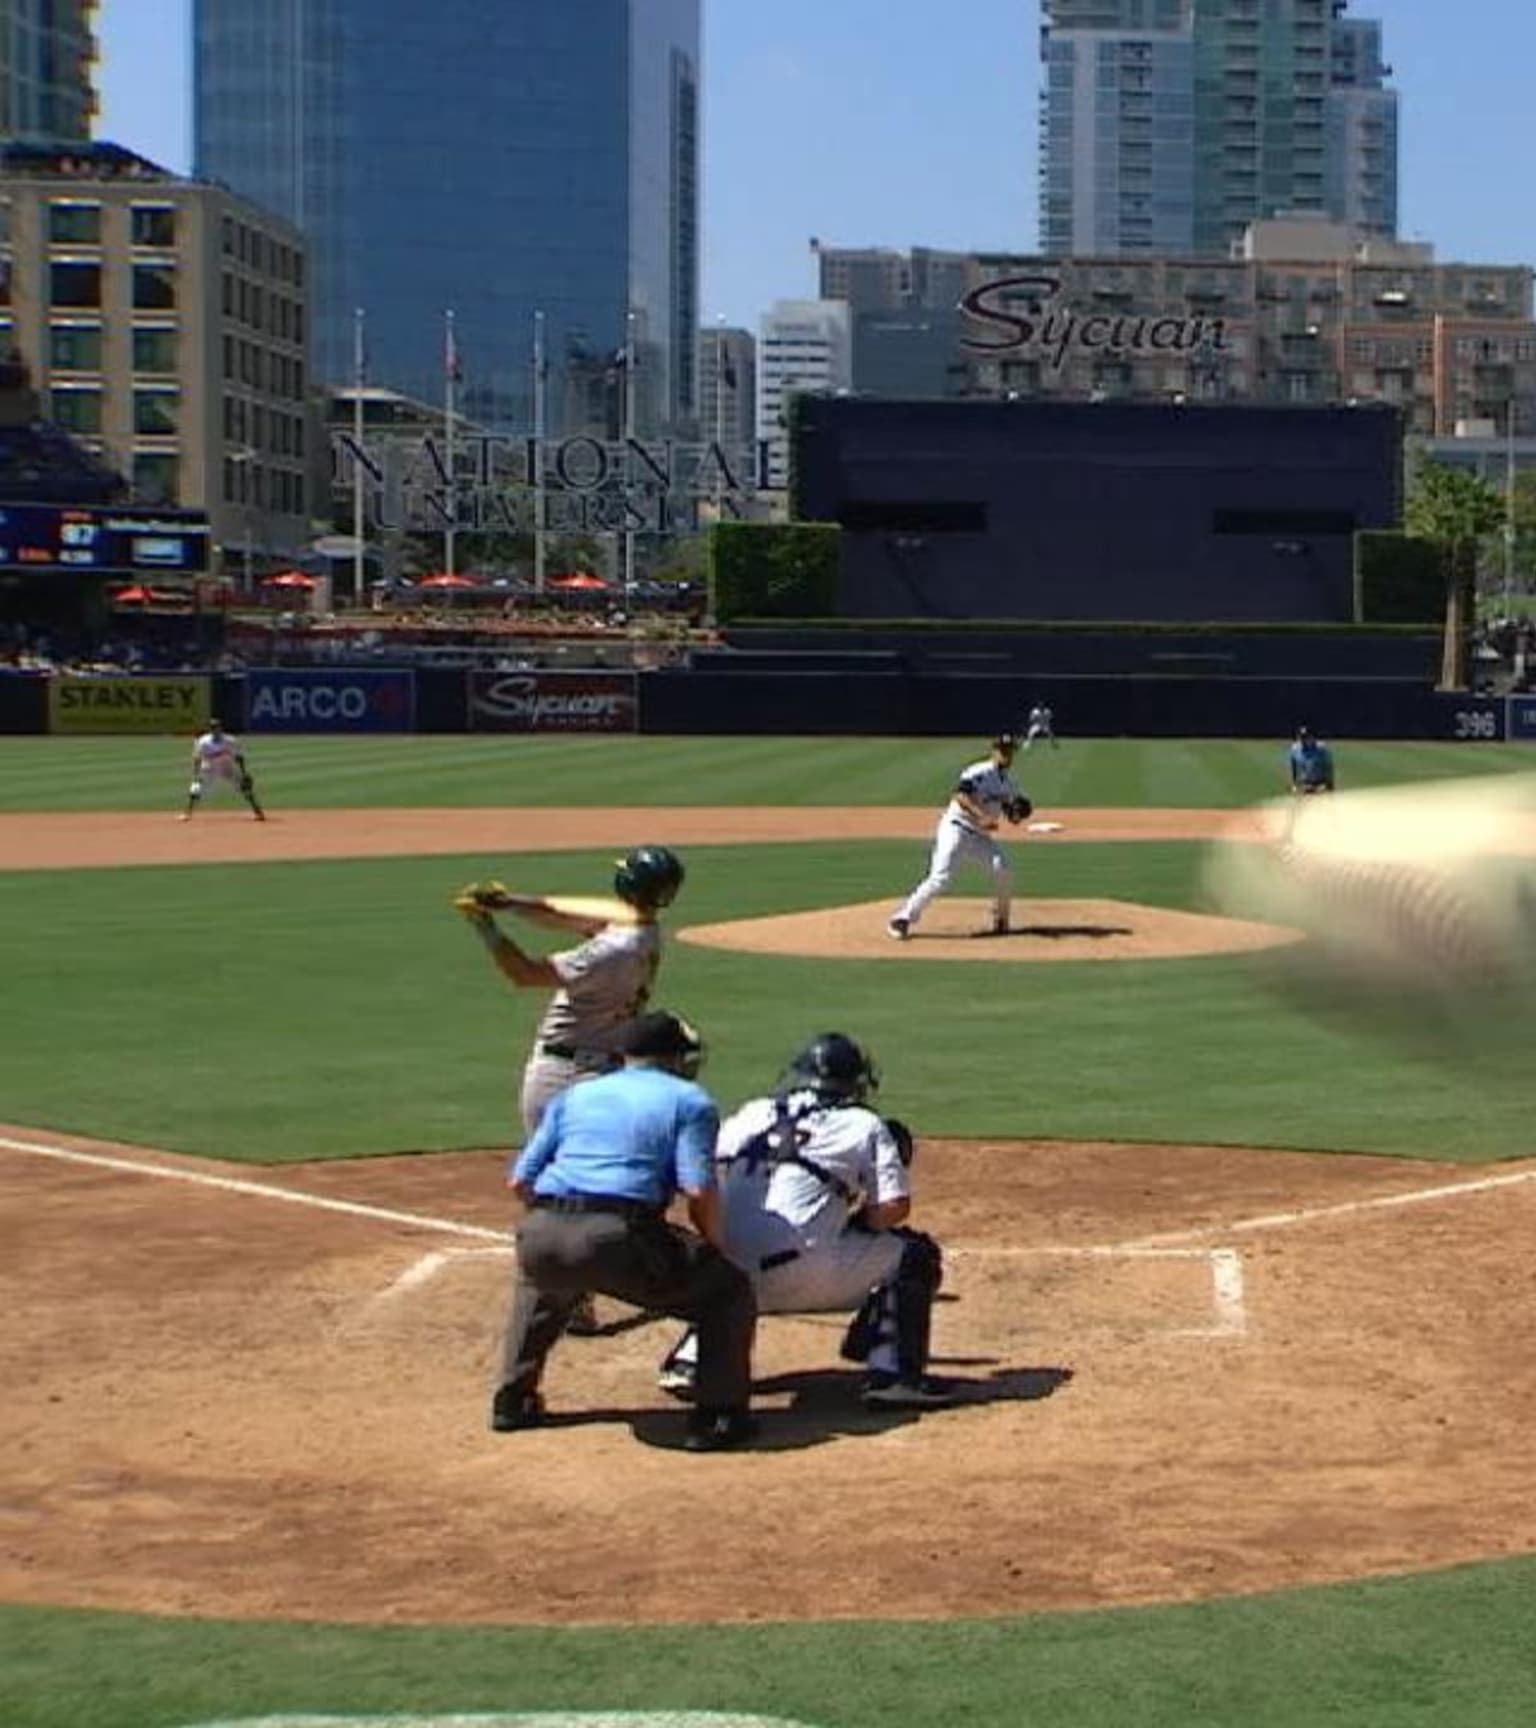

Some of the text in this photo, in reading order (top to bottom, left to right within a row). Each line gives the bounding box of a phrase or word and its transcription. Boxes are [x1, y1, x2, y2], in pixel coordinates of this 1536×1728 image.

[960, 276, 1228, 370] Sycuan
[331, 433, 788, 492] NATIONAL
[59, 685, 197, 709] STANLEY
[251, 686, 368, 719] ARCO
[473, 676, 621, 724] Sycuan
[1454, 711, 1497, 737] 396
